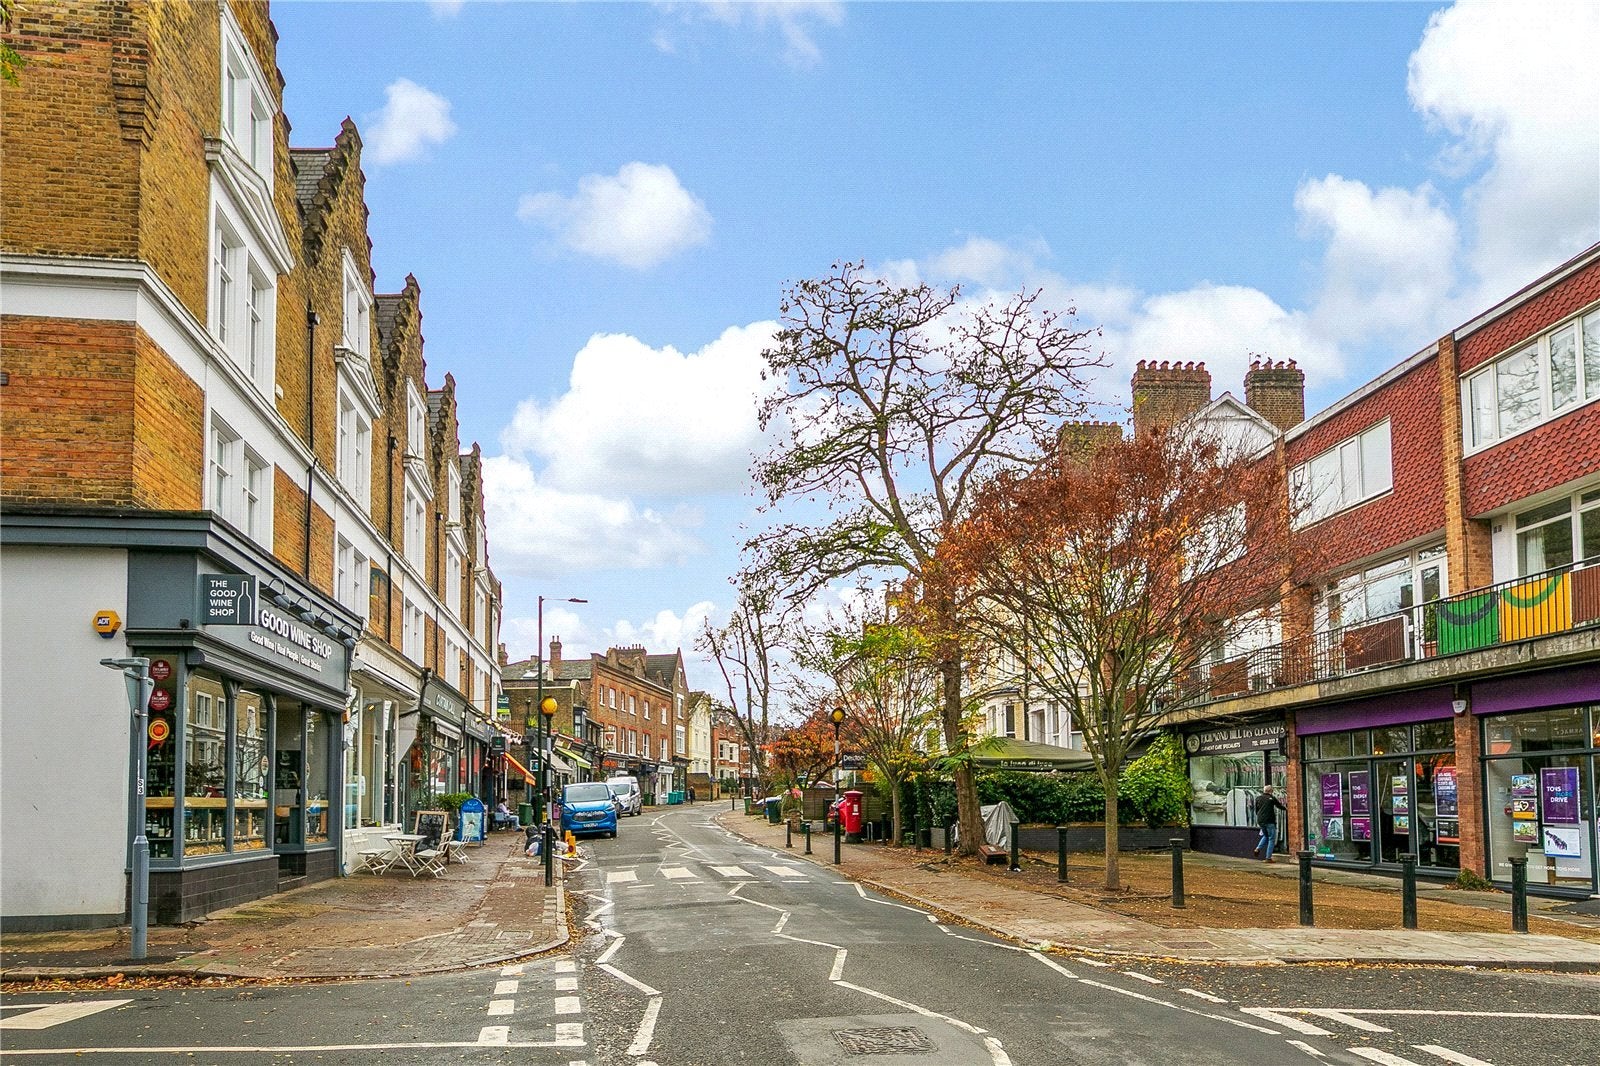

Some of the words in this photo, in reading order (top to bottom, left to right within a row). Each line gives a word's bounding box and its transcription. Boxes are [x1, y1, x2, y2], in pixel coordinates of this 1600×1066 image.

[261, 609, 289, 638] GOOD
[290, 624, 312, 650] WINE
[312, 637, 332, 660] SHOP
[250, 631, 264, 646] Good
[264, 637, 274, 651] Wine
[277, 643, 286, 656] Real
[286, 647, 299, 662] People
[1230, 729, 1242, 740] HILL
[421, 814, 444, 825] OPEN
